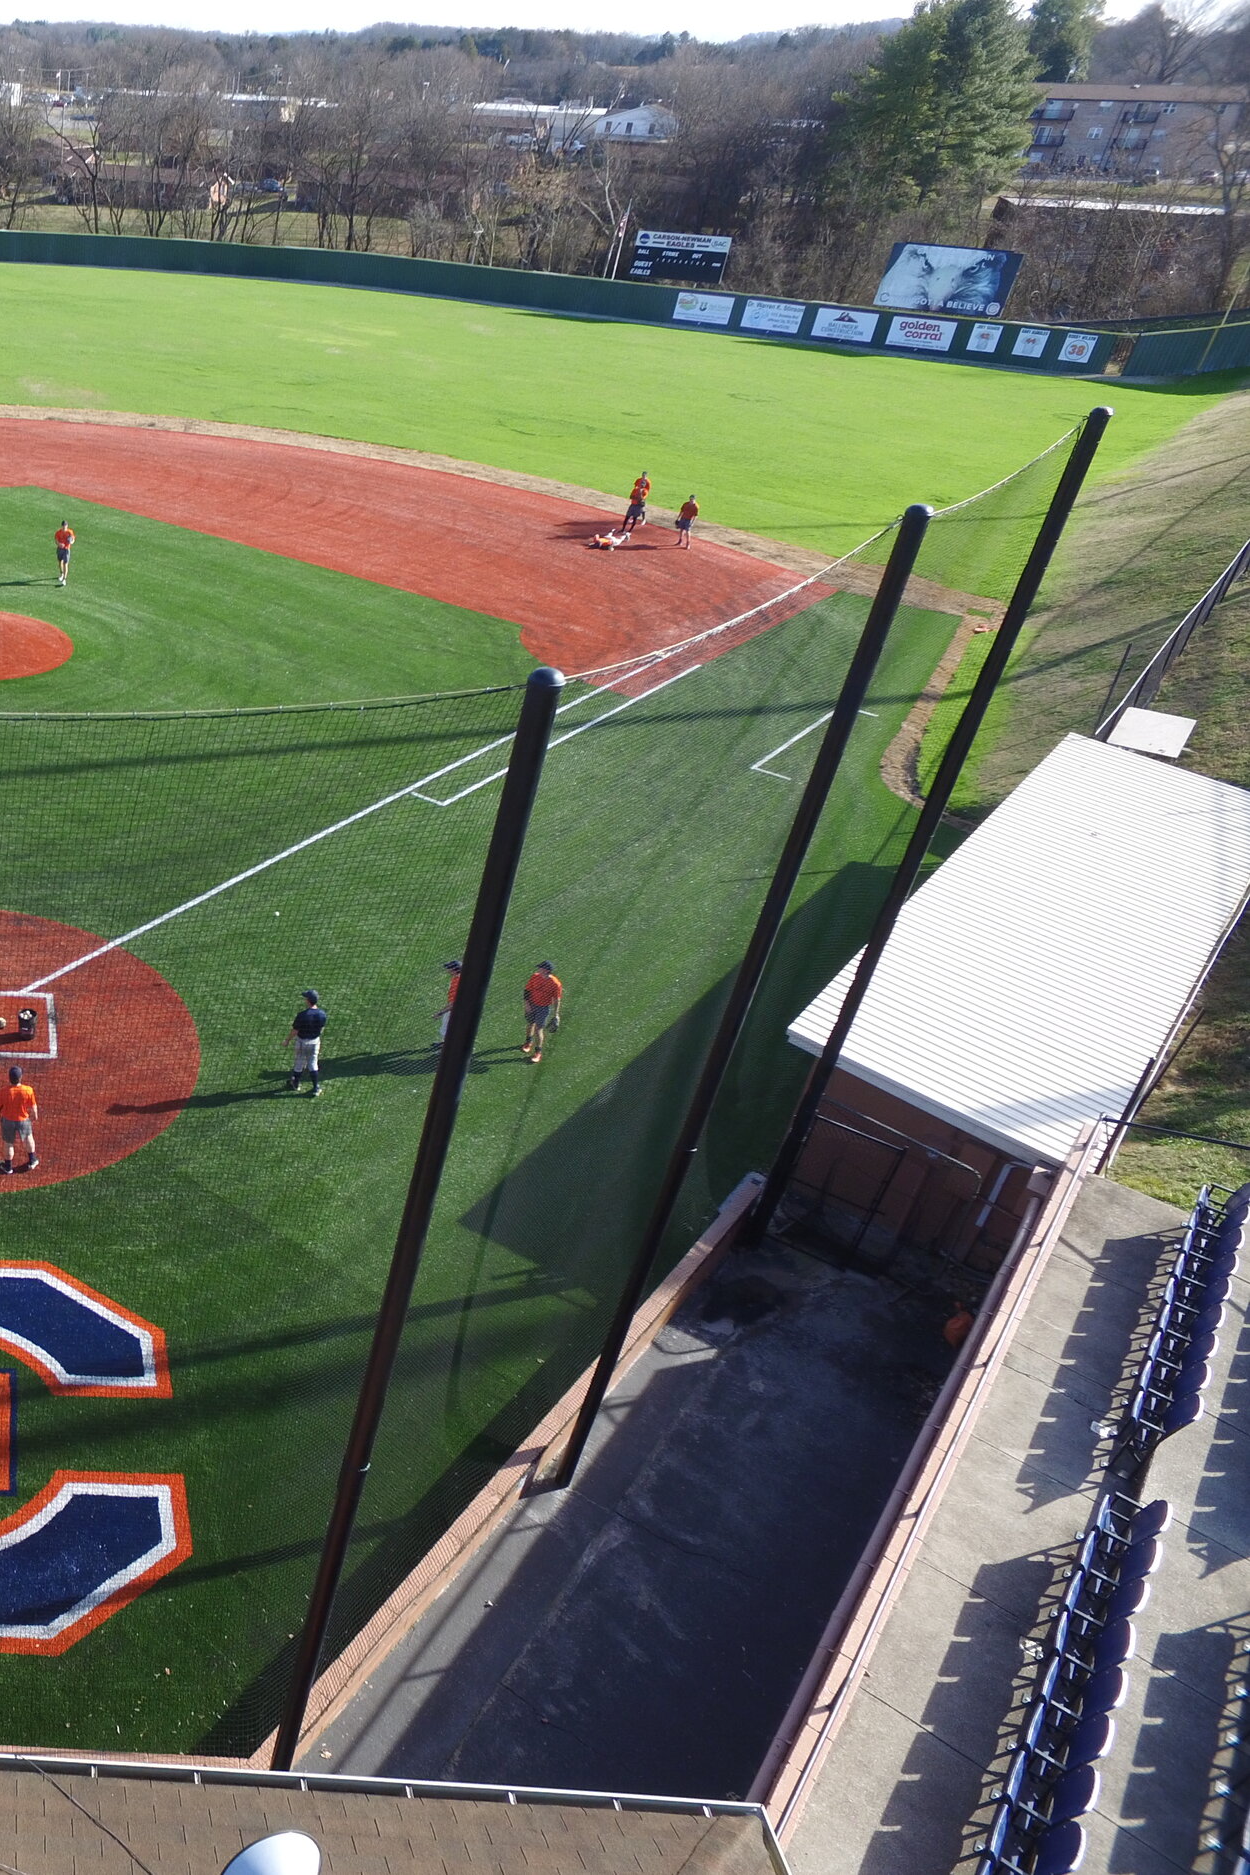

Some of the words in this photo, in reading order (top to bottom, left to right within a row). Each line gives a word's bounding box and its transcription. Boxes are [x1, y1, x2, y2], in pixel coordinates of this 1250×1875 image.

[652, 233, 712, 243] CARSON-NEWMAN
[666, 240, 695, 249] EAGLES
[629, 267, 651, 275] EAGLES
[946, 301, 986, 312] BELIEVE
[899, 320, 940, 332] golden
[821, 326, 865, 337] CONSTRUCTION
[904, 331, 943, 341] corral
[1068, 344, 1086, 357] 38
